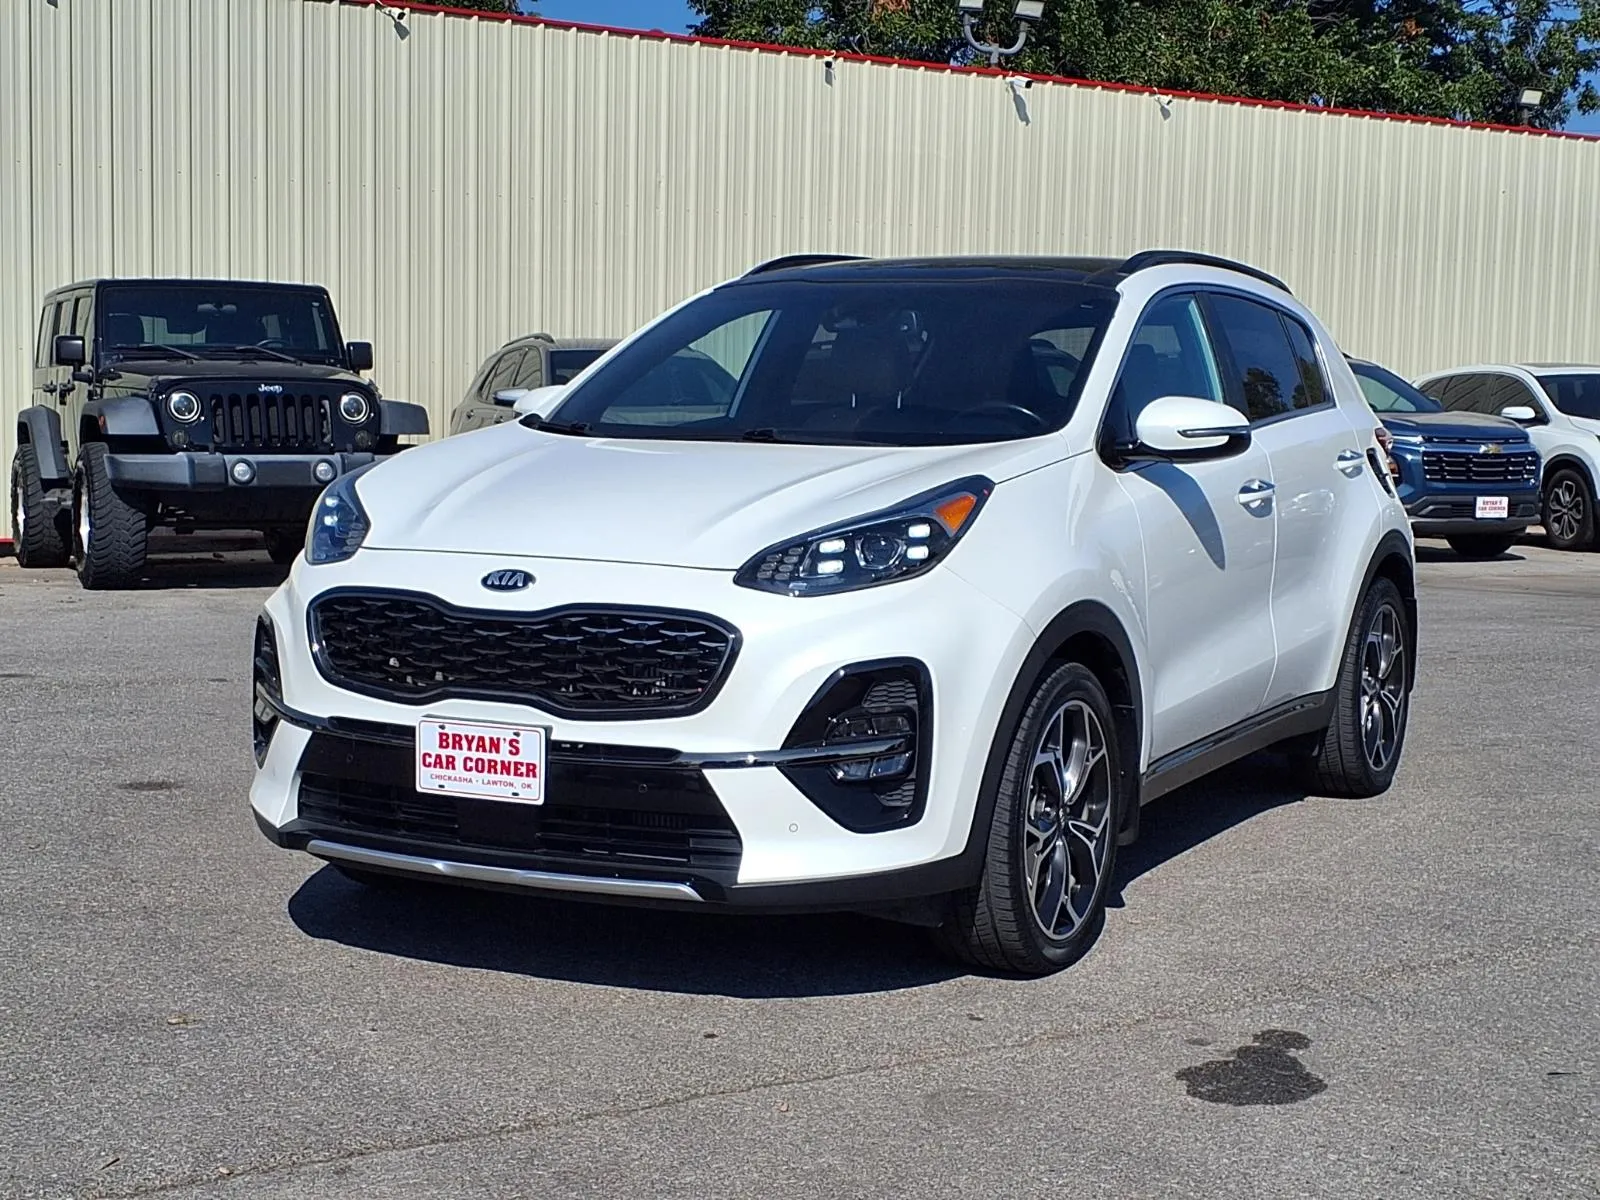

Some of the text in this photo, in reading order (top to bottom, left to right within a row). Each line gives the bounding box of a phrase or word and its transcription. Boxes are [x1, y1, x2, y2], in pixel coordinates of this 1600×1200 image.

[258, 383, 283, 394] Jeep
[486, 571, 525, 587] KIA
[438, 732, 520, 756] BRYAN'S
[422, 752, 537, 778] CAR CORNER
[430, 773, 473, 784] CHICKASHA
[481, 779, 517, 789] LAWTON,
